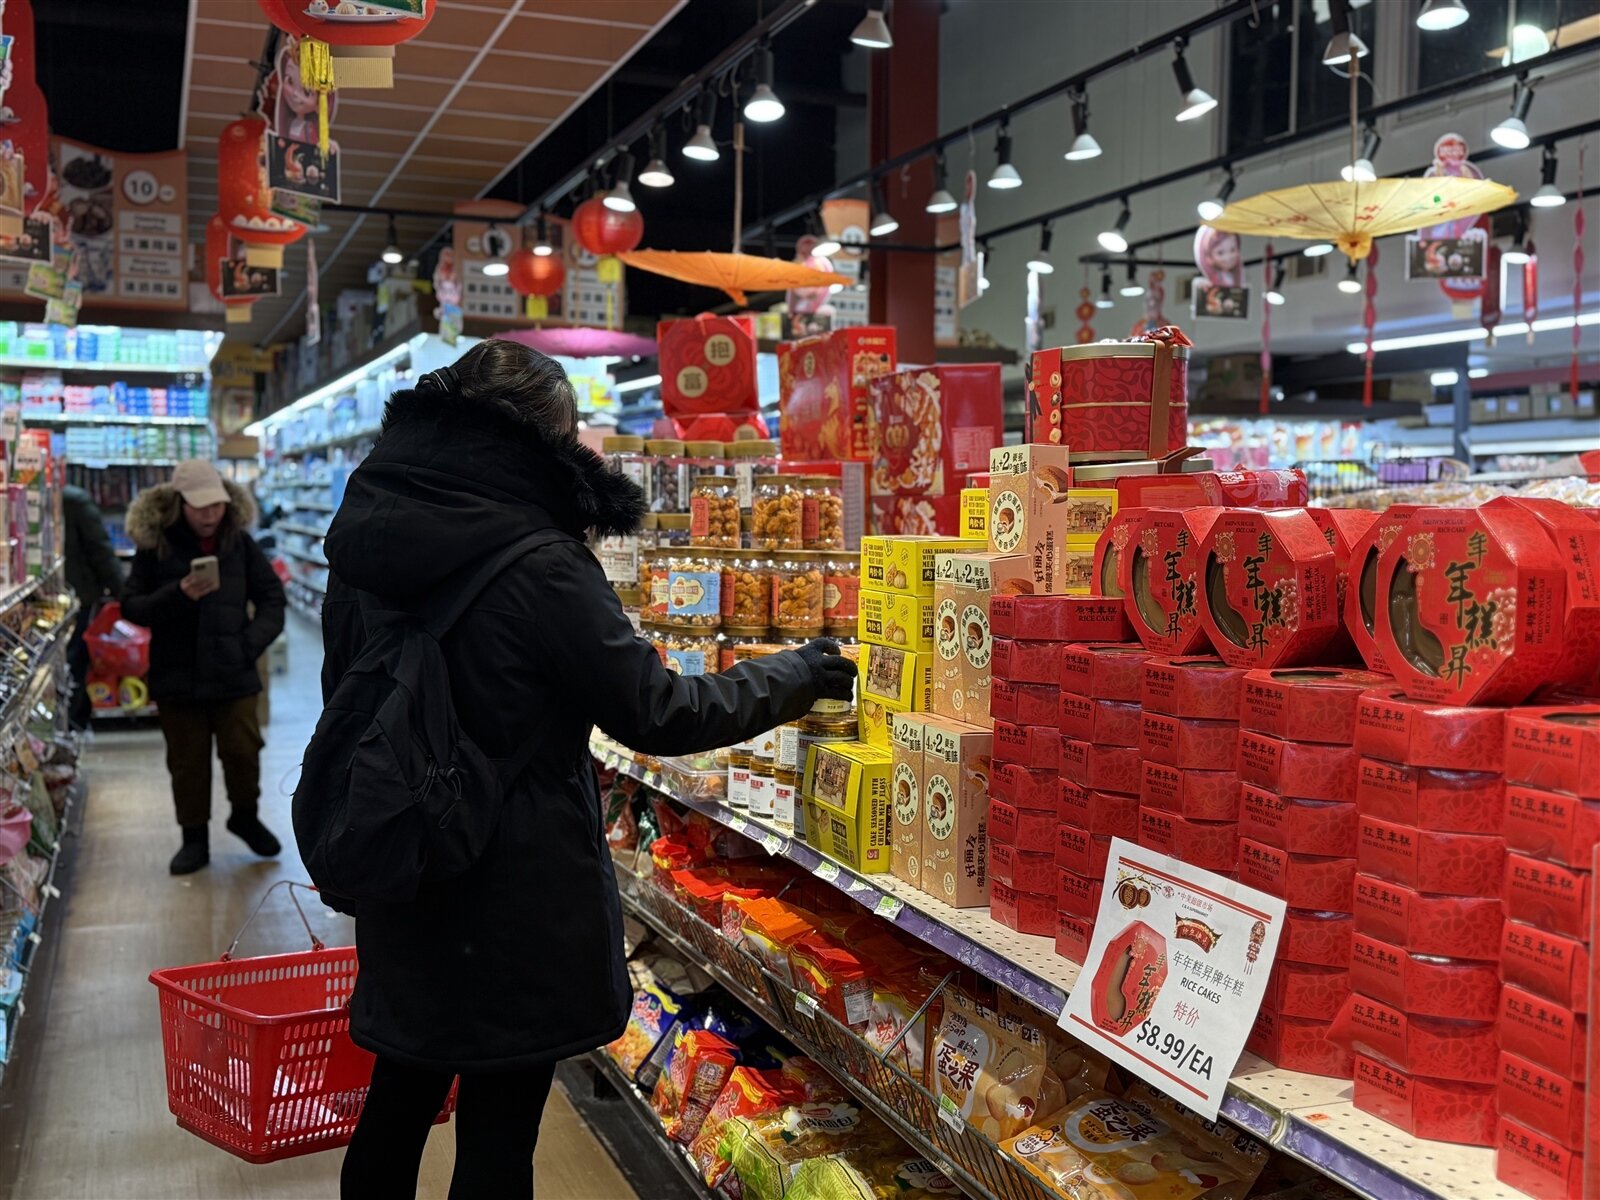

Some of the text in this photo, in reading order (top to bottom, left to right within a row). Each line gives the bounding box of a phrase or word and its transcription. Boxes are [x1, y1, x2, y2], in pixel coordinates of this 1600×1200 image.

[130, 180, 153, 196] 10
[1034, 540, 1046, 583] 好丽友
[1045, 530, 1054, 592] 绵融夹心蛋糕
[1012, 738, 1026, 746] CAKE
[878, 777, 886, 797] FLOSS
[870, 798, 878, 829] SEASONED
[870, 830, 878, 846] CAKE
[964, 833, 978, 879] 好丽友
[1173, 950, 1245, 998] 年年糕昇牌年糕
[1180, 976, 1222, 1005] RICE CAKES
[1173, 1000, 1200, 1030] 特价
[1136, 1017, 1214, 1081] $8.99/EA
